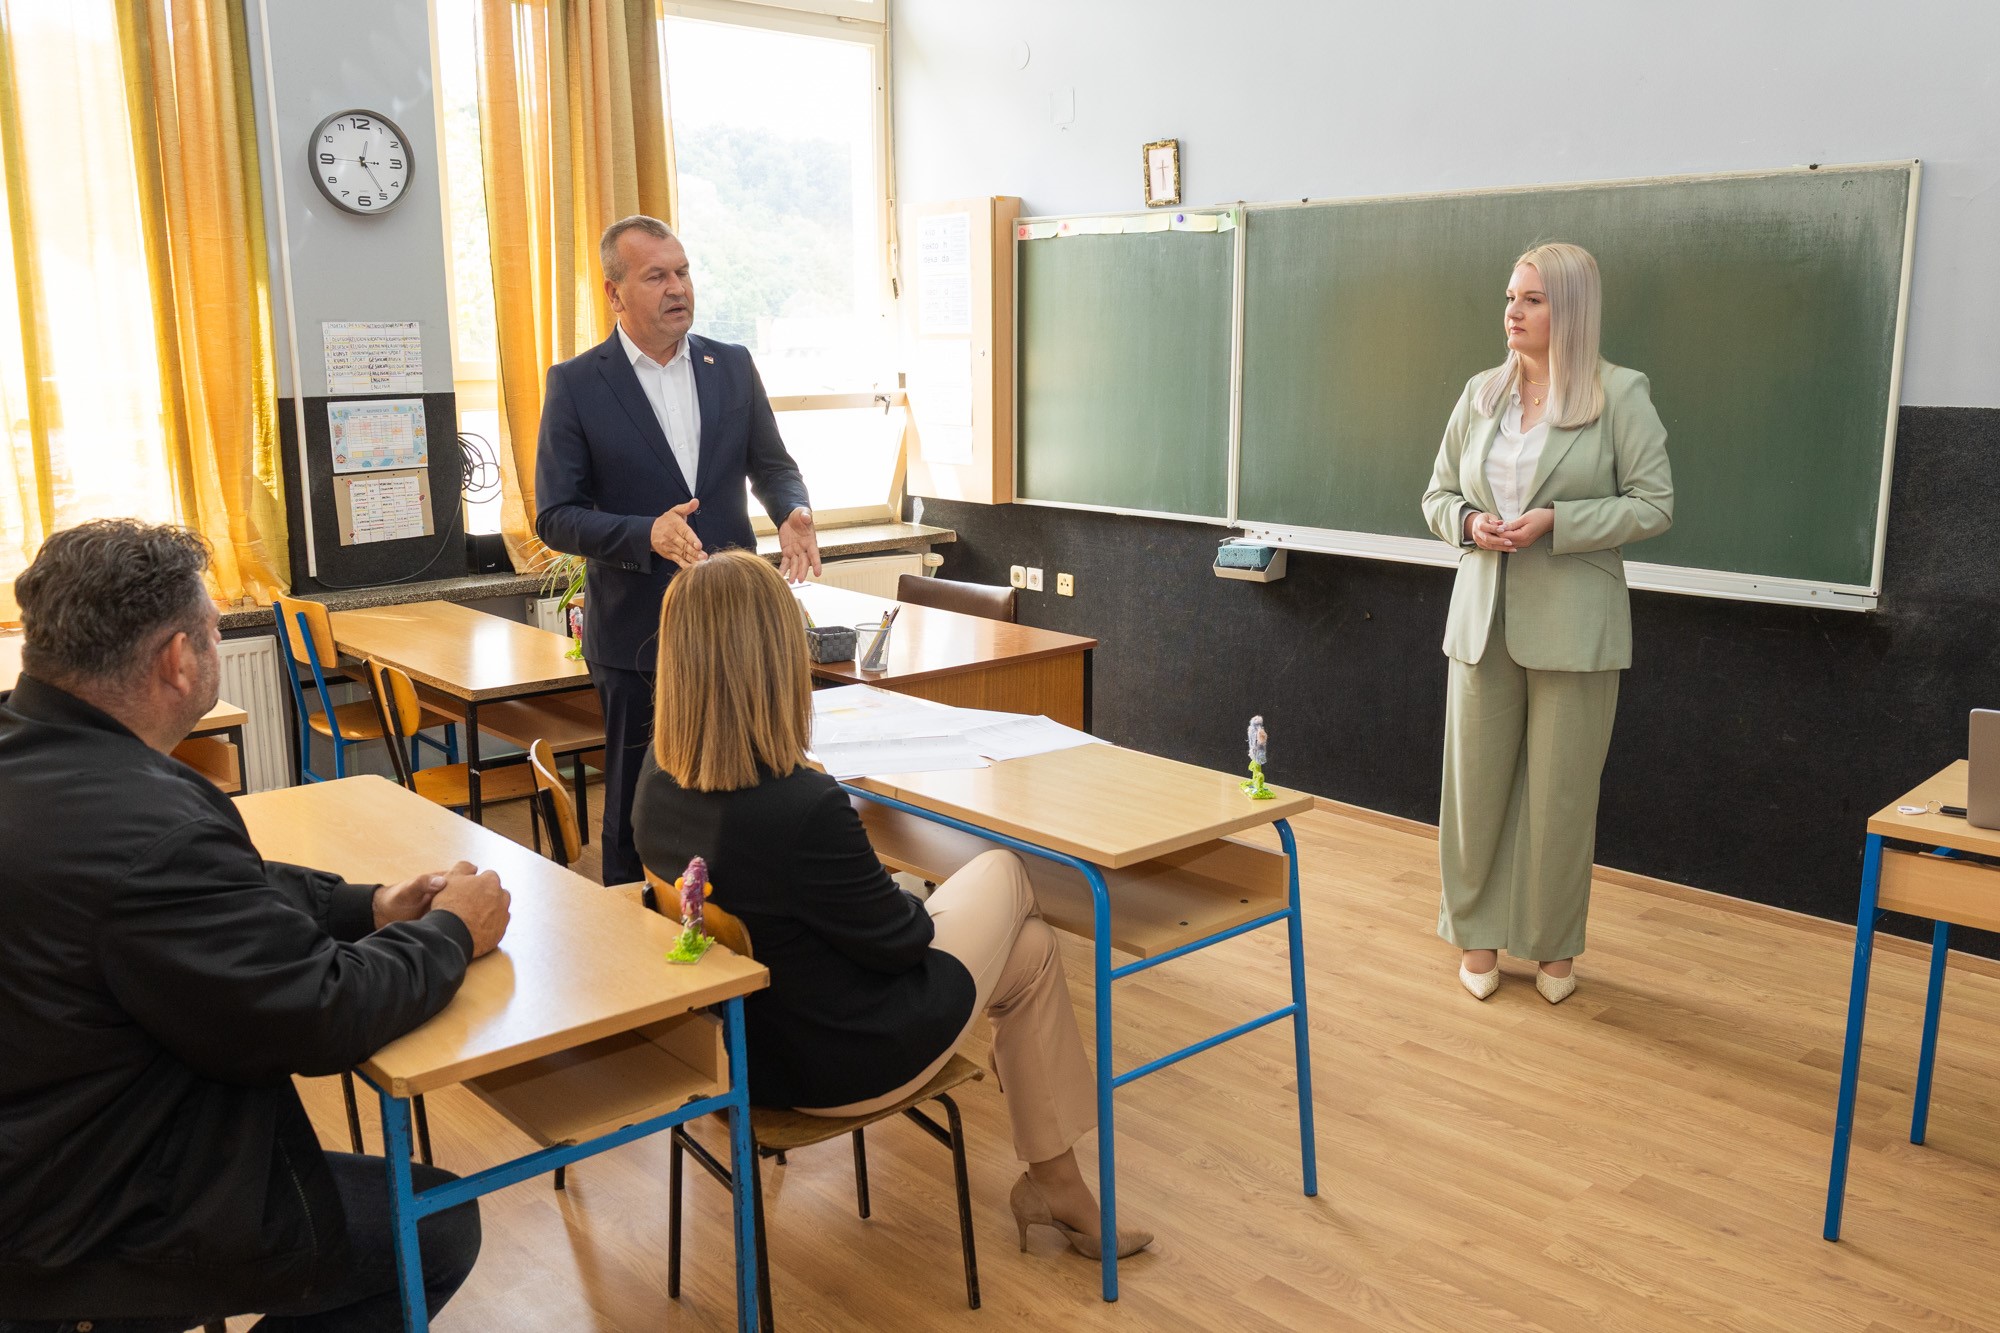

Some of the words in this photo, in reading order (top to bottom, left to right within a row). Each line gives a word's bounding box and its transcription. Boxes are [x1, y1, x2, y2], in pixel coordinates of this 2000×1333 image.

[350, 118, 370, 130] 12
[324, 135, 334, 143] 10
[320, 153, 335, 165] 9
[390, 158, 402, 170] 3
[358, 196, 372, 206] 6
